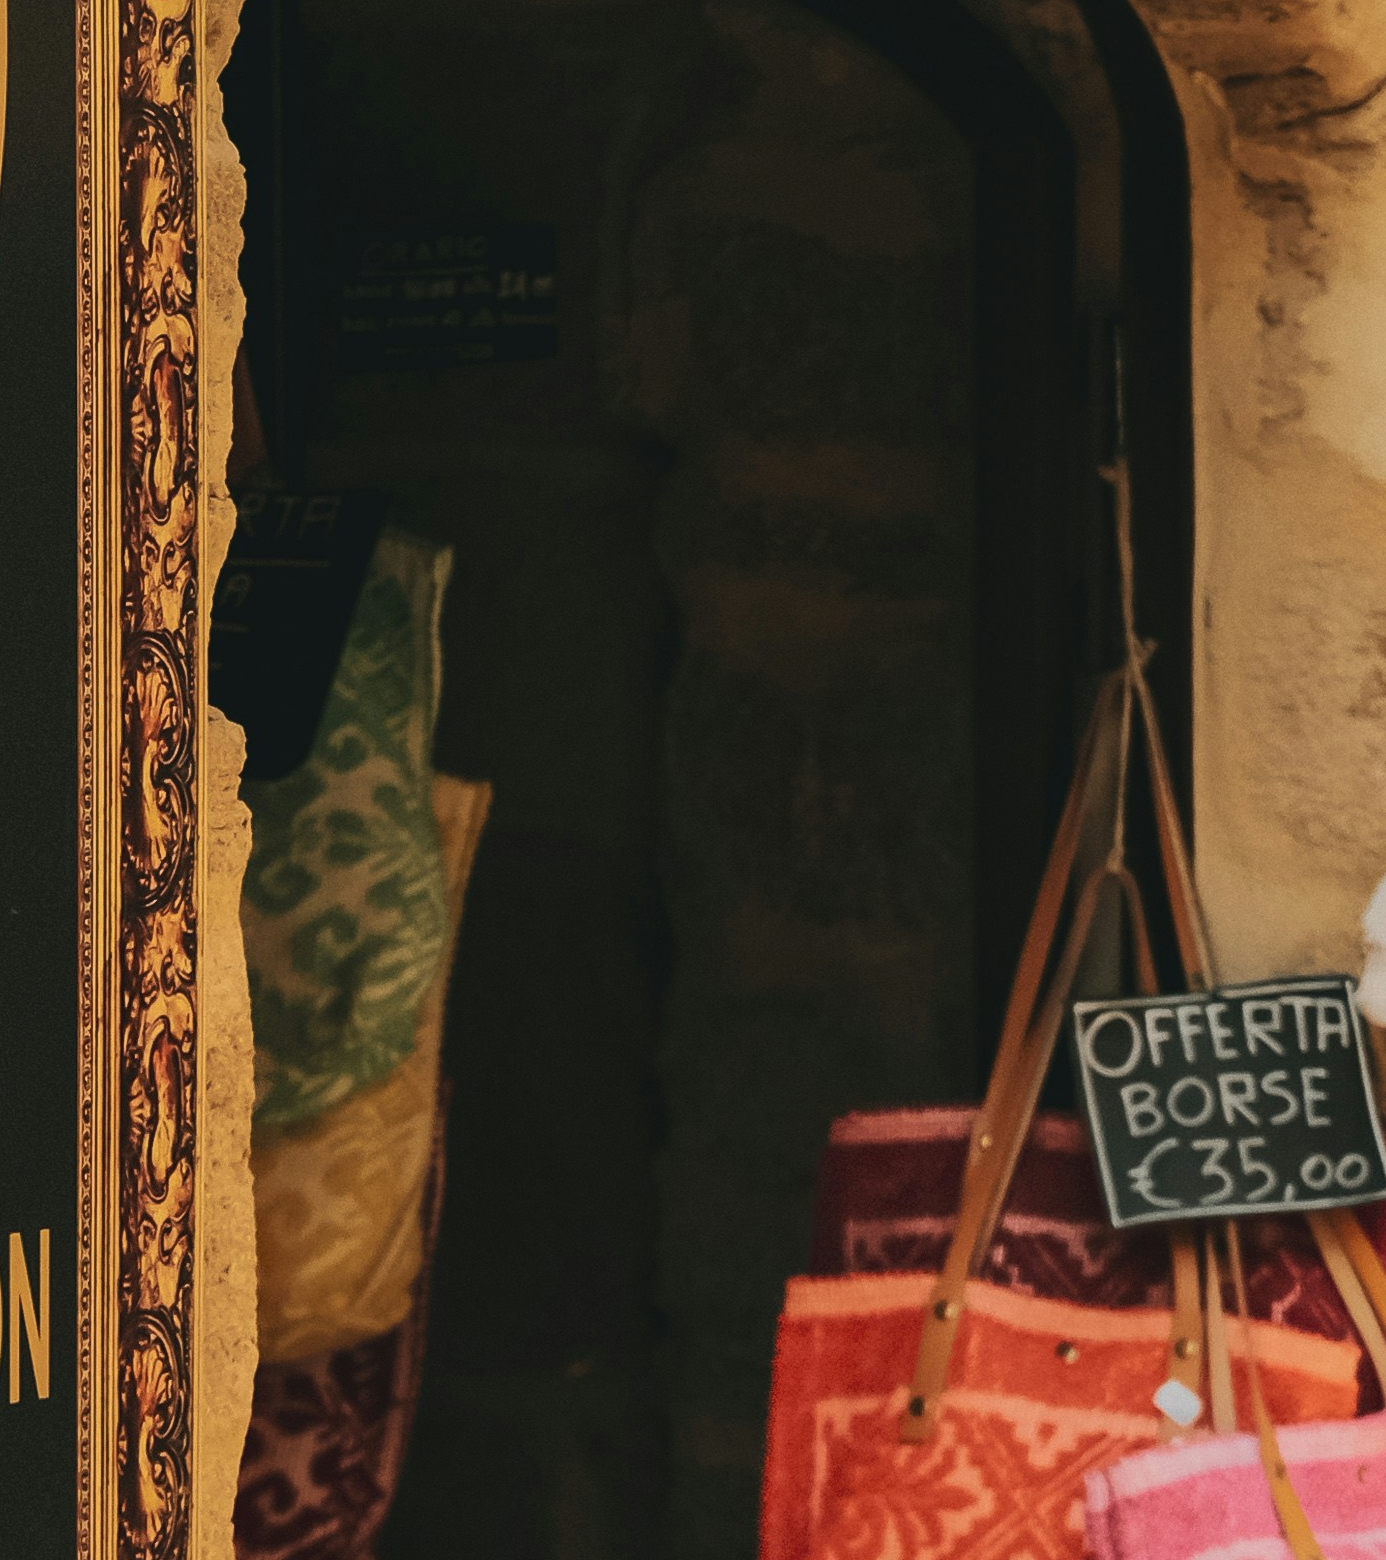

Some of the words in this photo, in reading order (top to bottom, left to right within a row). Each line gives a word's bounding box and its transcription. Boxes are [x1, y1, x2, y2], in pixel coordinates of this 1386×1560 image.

[1084, 996, 1351, 1078] OFFERTA
[1120, 1068, 1332, 1137] BORSE
[1127, 1136, 1371, 1209] €35,00
